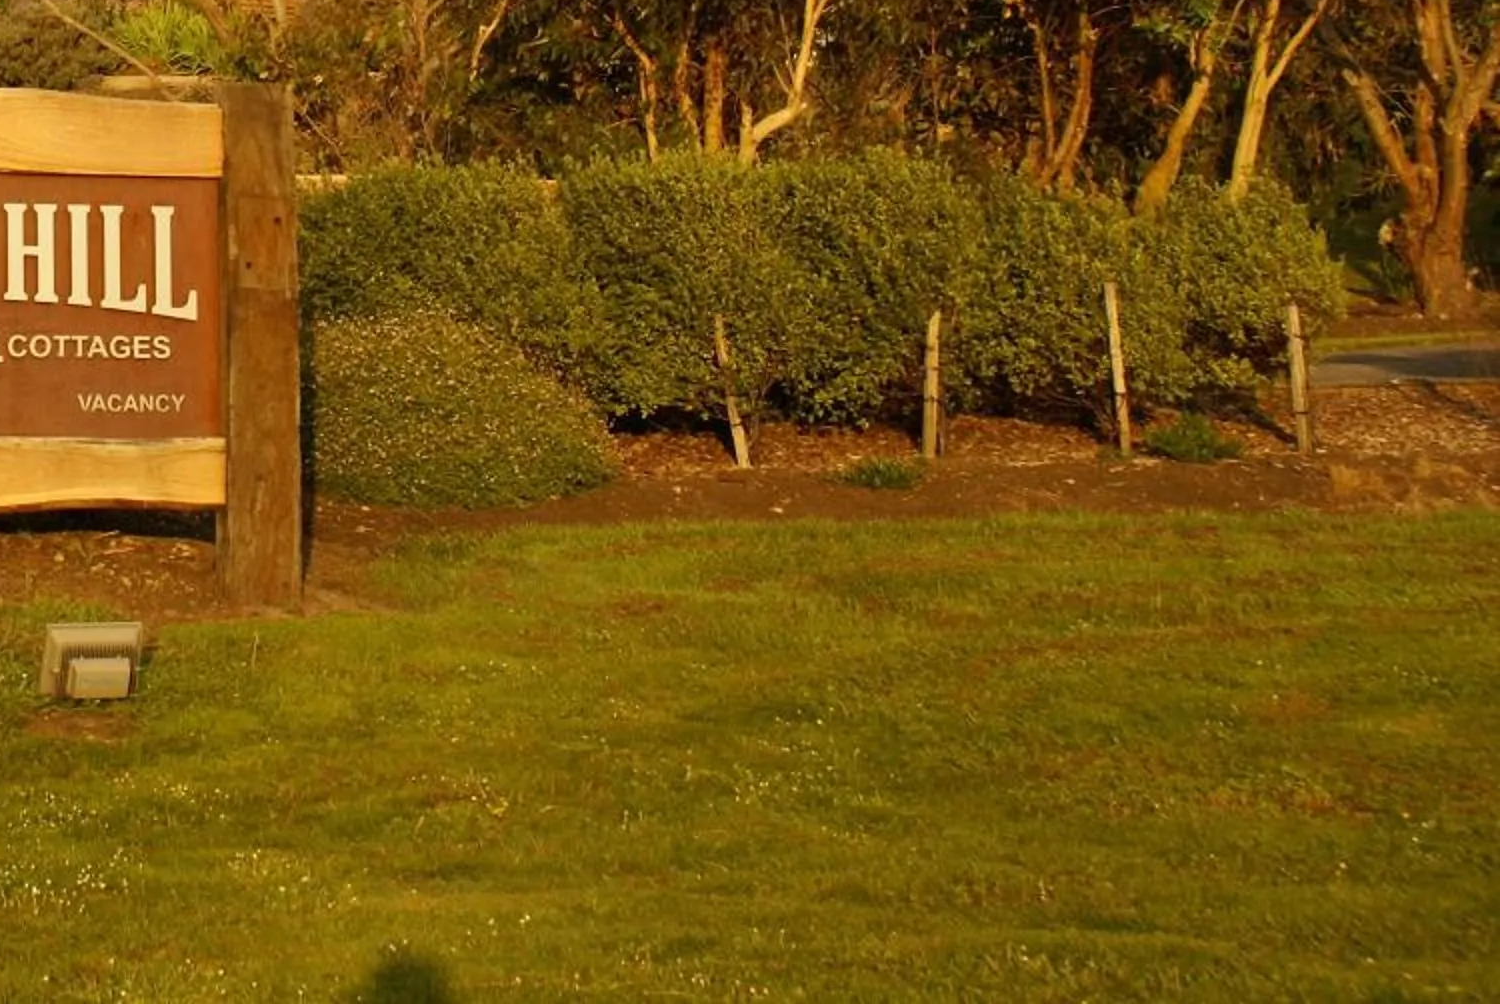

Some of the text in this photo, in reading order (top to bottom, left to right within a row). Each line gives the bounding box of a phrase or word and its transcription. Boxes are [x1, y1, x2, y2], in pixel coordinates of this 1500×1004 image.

[3, 201, 199, 322] HILL
[7, 334, 172, 359] COTTAGES
[77, 393, 186, 413] VACANCY
